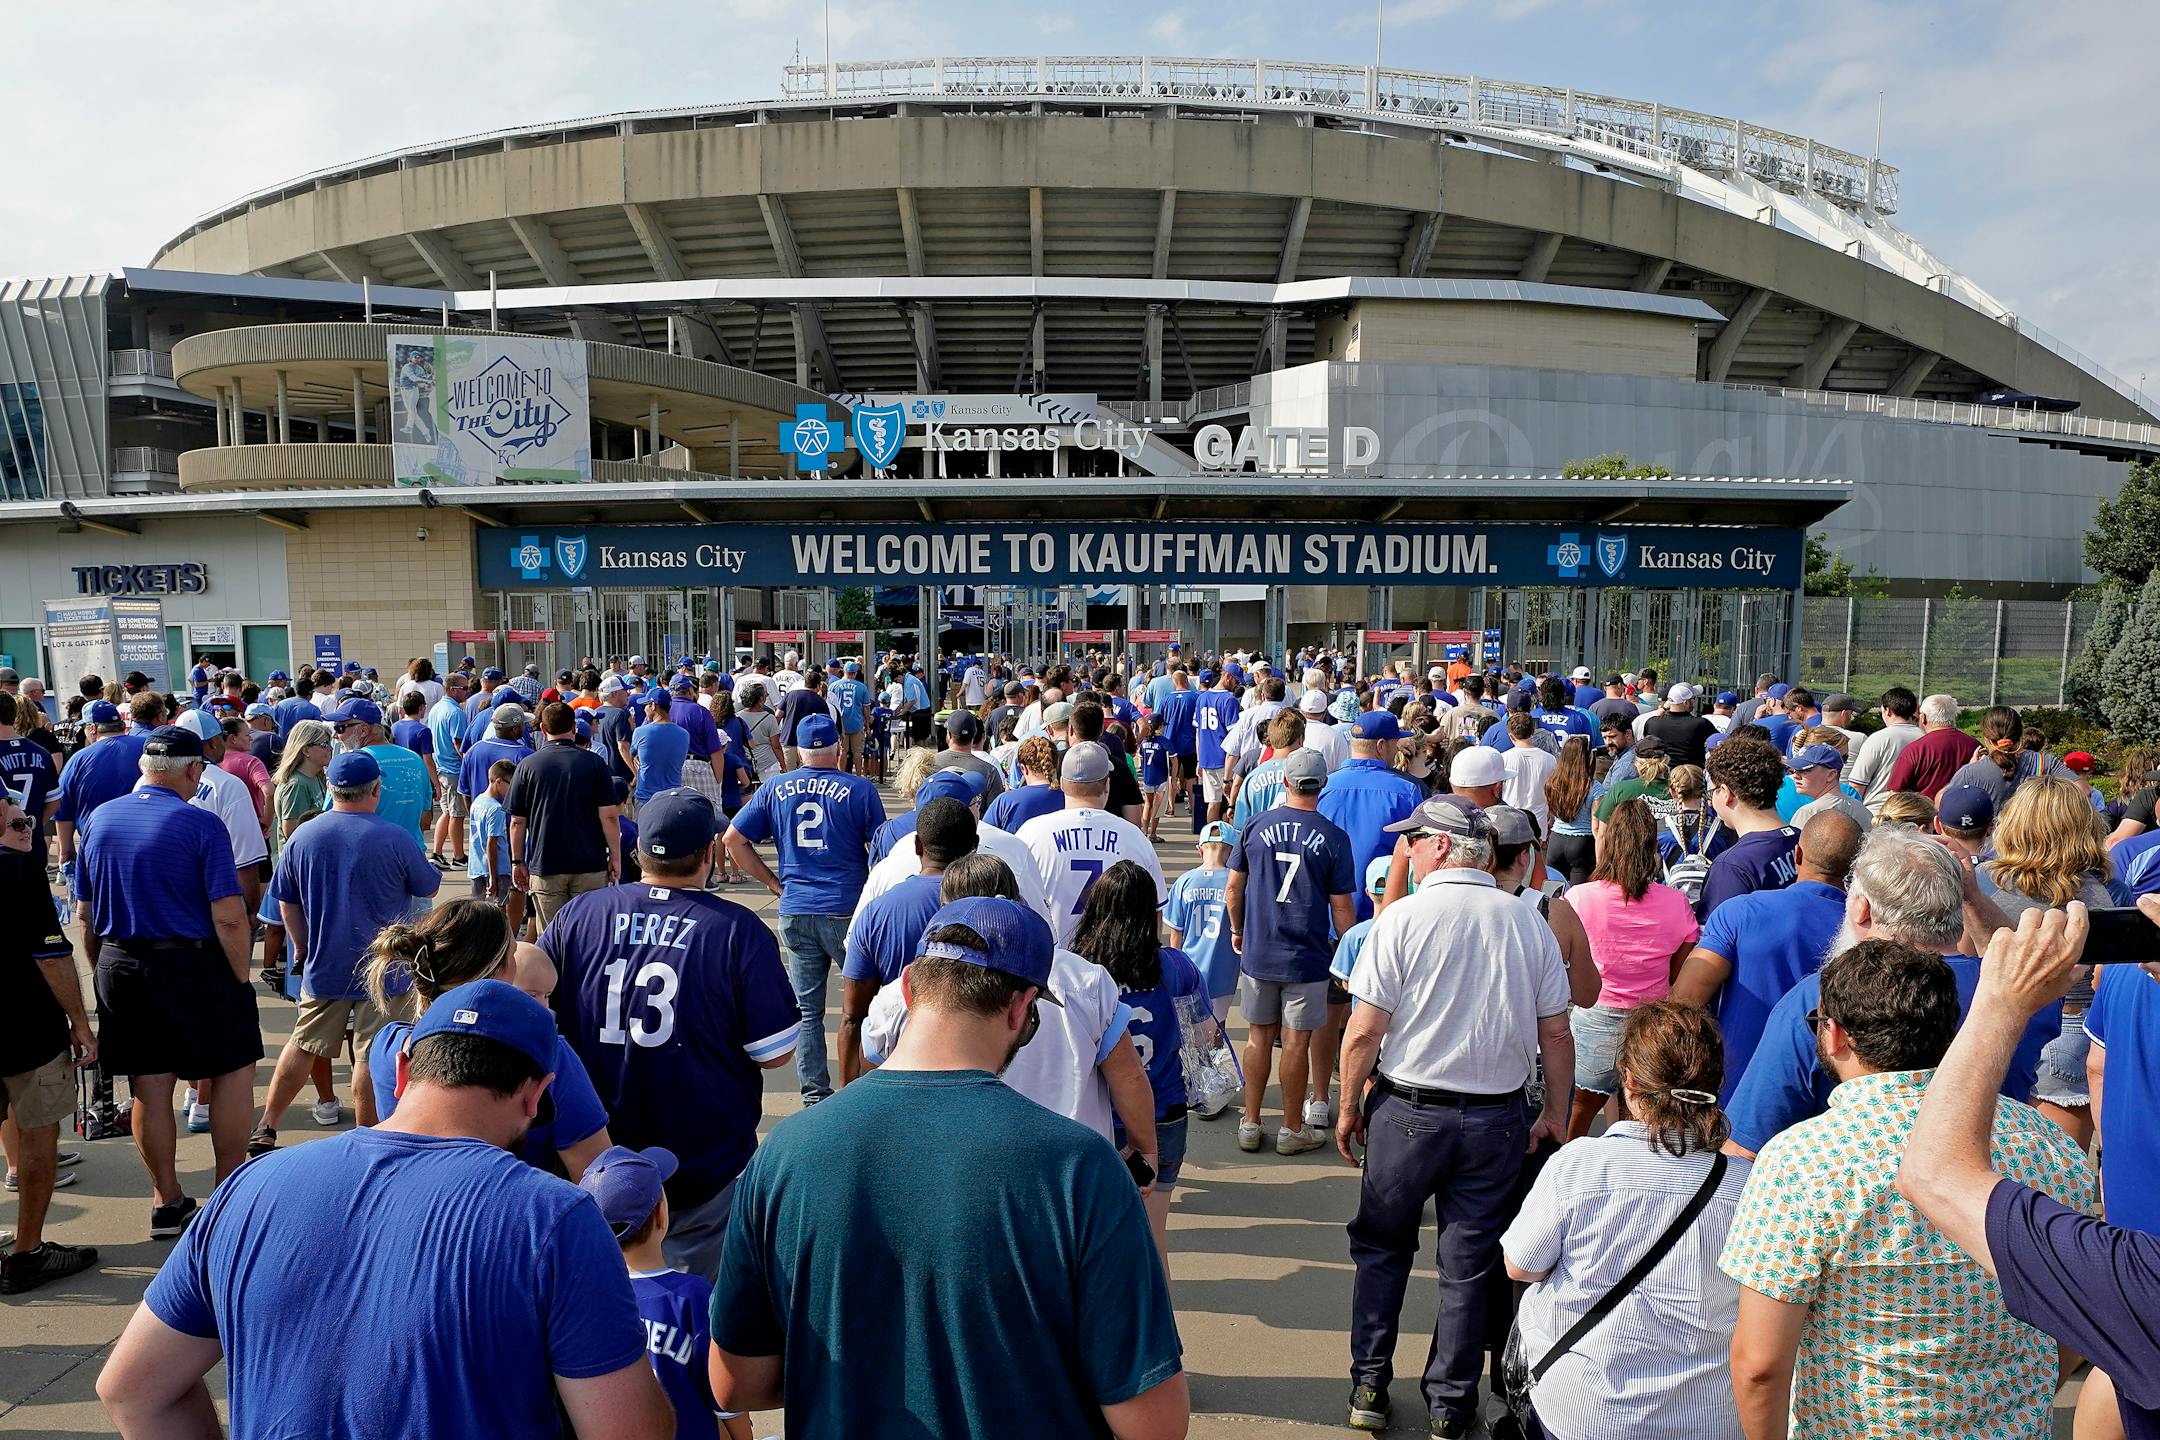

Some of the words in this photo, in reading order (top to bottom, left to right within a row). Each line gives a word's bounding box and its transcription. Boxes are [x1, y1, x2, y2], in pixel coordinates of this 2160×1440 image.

[453, 370, 527, 409] WELCOME
[535, 367, 551, 395] TO
[456, 413, 491, 431] THE
[484, 398, 557, 448] City
[951, 404, 989, 415] Kansas
[991, 404, 1012, 417] City
[921, 420, 1060, 452] Kansas
[1073, 419, 1152, 458] City
[1194, 424, 1329, 469] GATE
[1343, 426, 1380, 466] D
[497, 449, 516, 469] KC
[599, 546, 687, 569] Kansas
[695, 545, 746, 574] City
[791, 534, 991, 574] WELCOME
[1002, 532, 1054, 573] TO
[1068, 533, 1291, 574] KAUFFMAN
[1303, 533, 1498, 574] STADIUM.
[1639, 546, 1722, 569] Kansas
[1730, 547, 1776, 575] City
[71, 562, 207, 595] TICKETS
[120, 653, 129, 661] OF
[130, 652, 165, 661] CONDUCT
[123, 644, 137, 653] FAN
[137, 644, 158, 653] CODE
[843, 691, 853, 708] 5
[1200, 706, 1219, 731] 16
[1541, 714, 1569, 726] PEREZ
[0, 753, 26, 771] WITT
[30, 753, 45, 769] JR.
[1145, 749, 1155, 765] 7
[13, 774, 33, 810] 7
[775, 778, 850, 803] ESCOBAR
[1251, 769, 1285, 792] GORD
[796, 802, 824, 848] 2
[1053, 827, 1093, 853] WITT
[1095, 829, 1120, 856] JR.
[1259, 822, 1302, 848] WITT
[1302, 829, 1327, 857] JR.
[1275, 852, 1301, 903] 7
[1770, 849, 1797, 886] JAC
[1070, 860, 1103, 915] 7
[614, 912, 698, 950] PEREZ
[1193, 904, 1221, 939] 15
[600, 958, 679, 1048] 13
